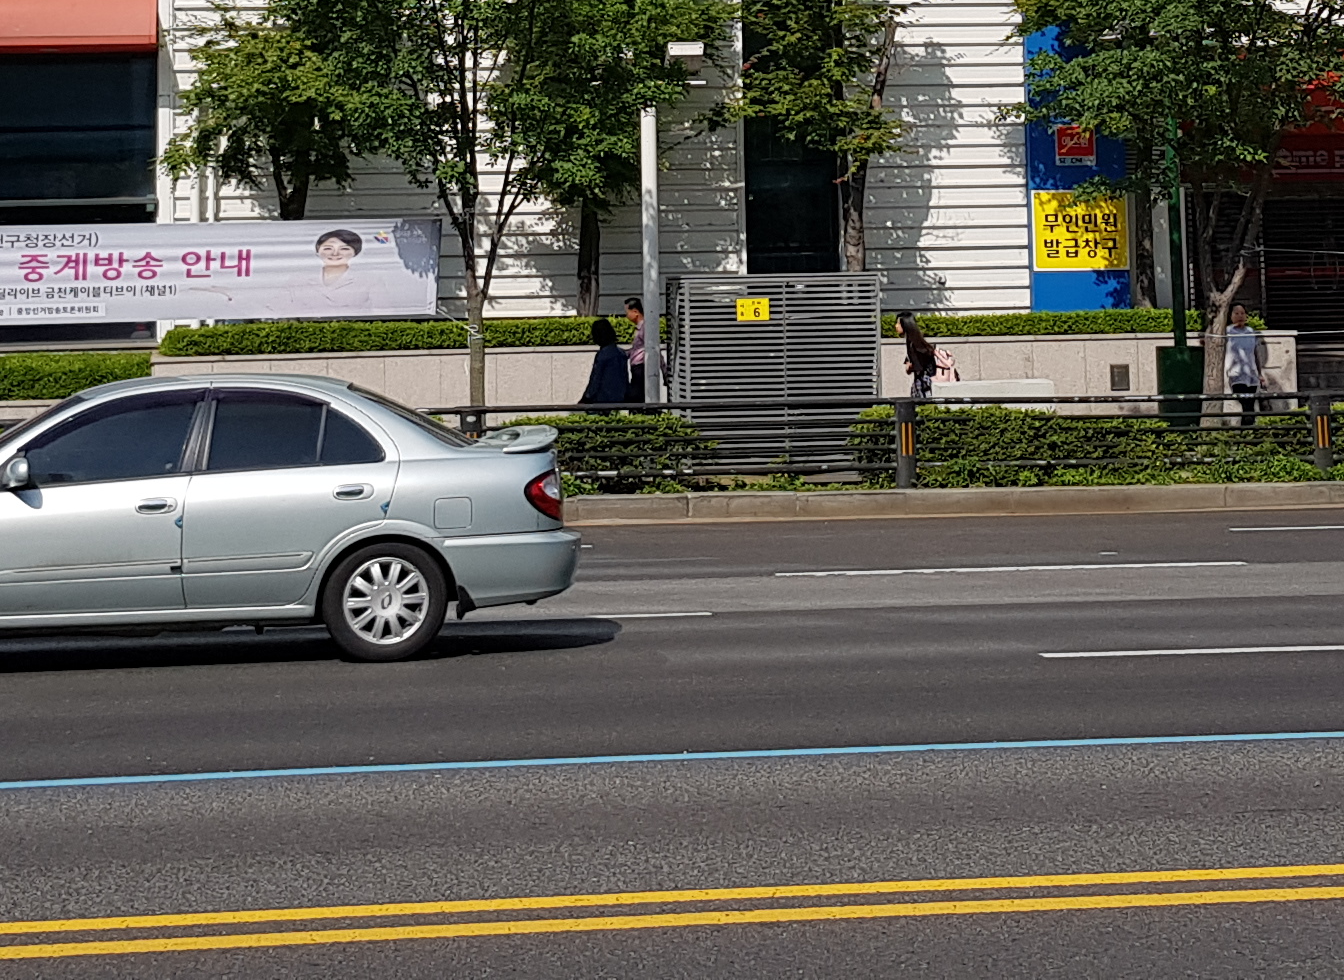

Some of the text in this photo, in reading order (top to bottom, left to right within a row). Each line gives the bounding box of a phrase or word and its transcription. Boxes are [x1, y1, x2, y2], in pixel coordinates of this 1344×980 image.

[1276, 148, 1329, 166] ome
[1043, 213, 1119, 234] 무인민원
[1044, 238, 1119, 259] 발급창구
[18, 251, 163, 283] 중계방송
[181, 249, 252, 279] 안내
[45, 285, 136, 300] 금천케이블티브이
[140, 284, 177, 298] (채널1)
[753, 307, 761, 318] 6
